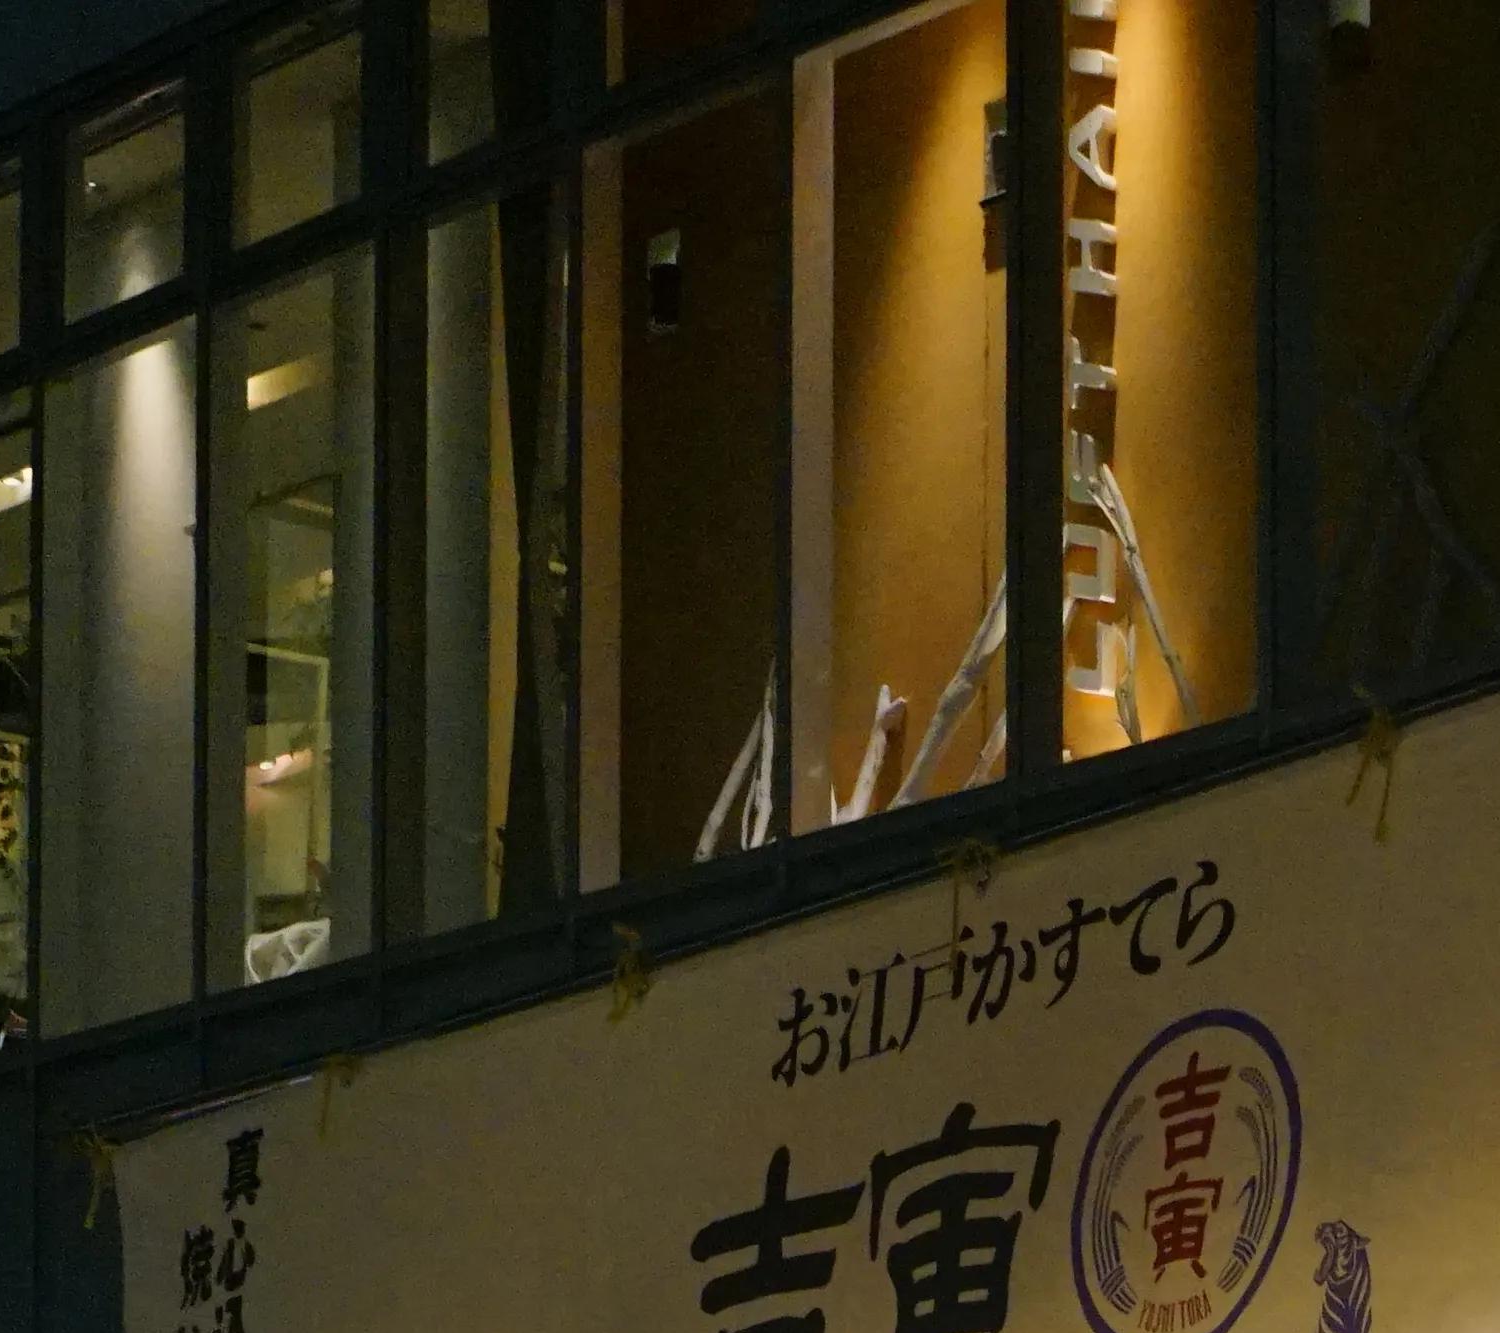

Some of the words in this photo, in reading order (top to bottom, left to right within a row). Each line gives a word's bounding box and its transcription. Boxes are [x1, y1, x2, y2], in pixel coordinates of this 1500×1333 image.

[772, 859, 1236, 1087] お江戸かすてら
[1143, 1051, 1231, 1283] 吉寅
